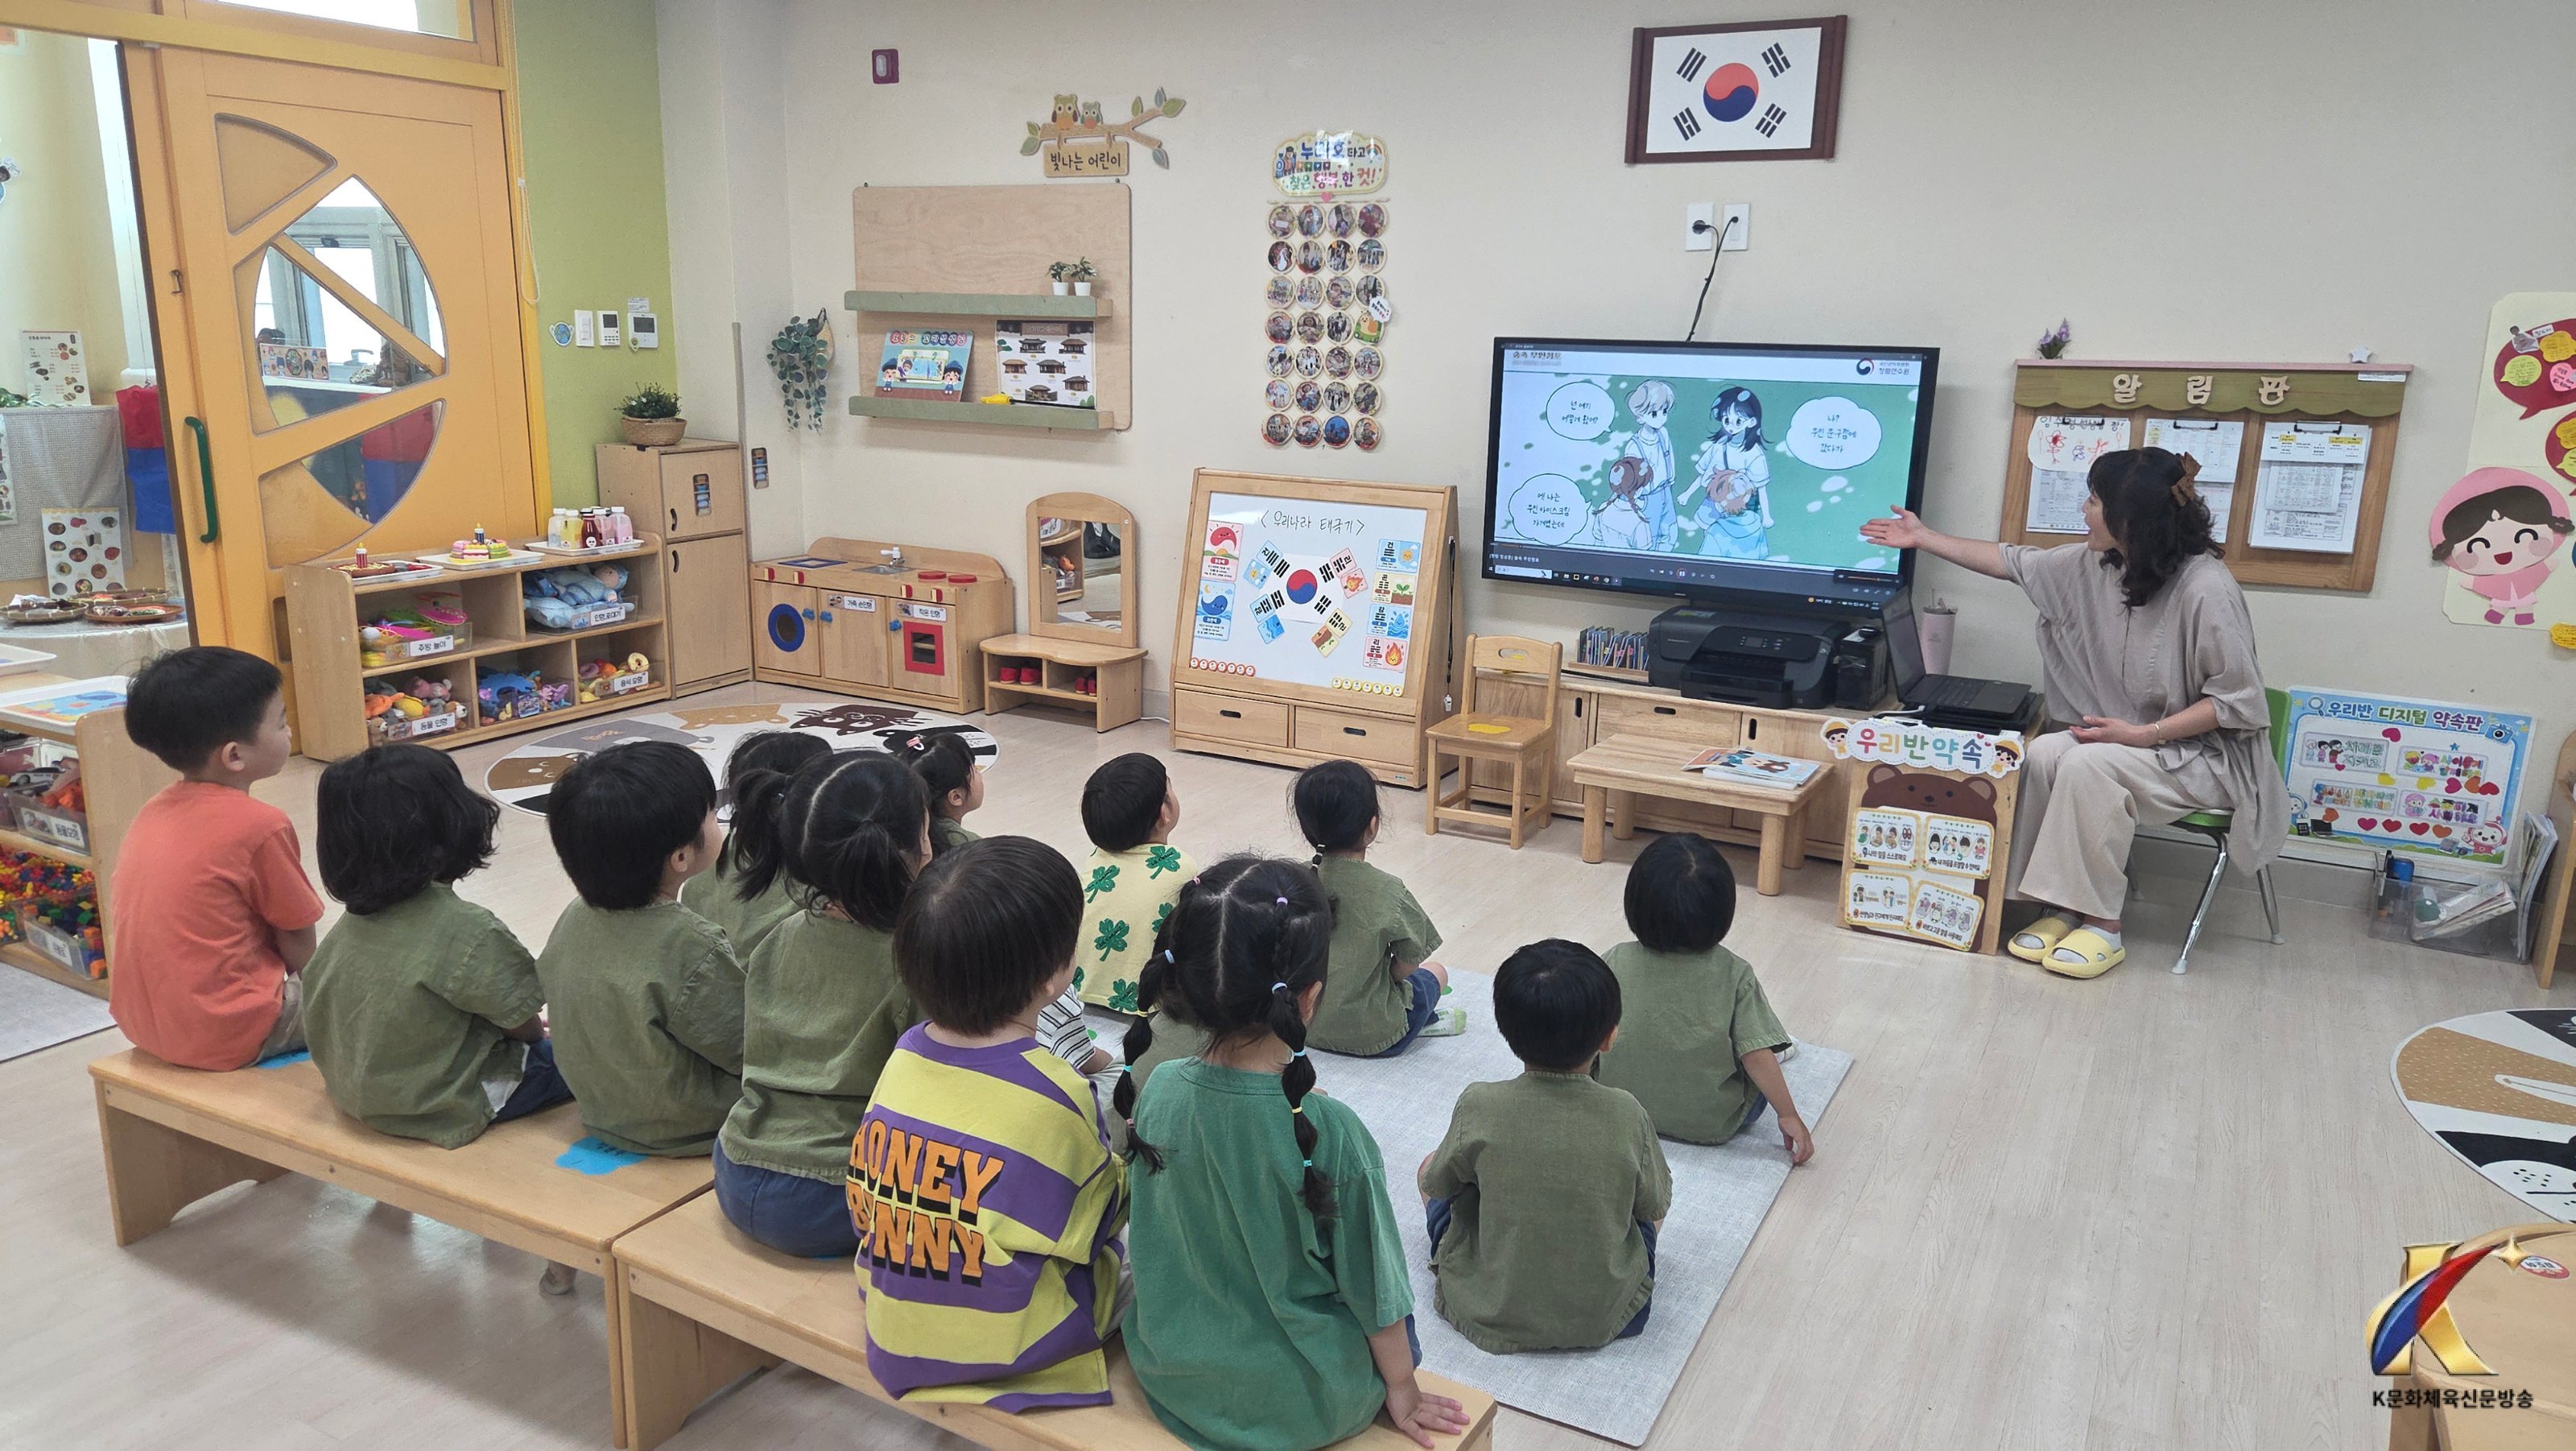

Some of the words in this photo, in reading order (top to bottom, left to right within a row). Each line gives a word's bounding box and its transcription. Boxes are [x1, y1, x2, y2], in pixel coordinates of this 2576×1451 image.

[1347, 147, 1366, 158] 타고
[1050, 151, 1084, 172] 빛나는
[1088, 151, 1121, 171] 어린이
[1290, 174, 1311, 191] 찾은
[1342, 172, 1355, 188] 한
[1356, 167, 1377, 187] 컷!
[1578, 402, 1591, 410] 여기
[418, 643, 431, 652] 주방
[2328, 701, 2373, 719] 우리반
[2378, 706, 2428, 725] 디지털
[2433, 710, 2484, 732] 약속판
[420, 721, 433, 731] 동물
[435, 717, 448, 728] 인형
